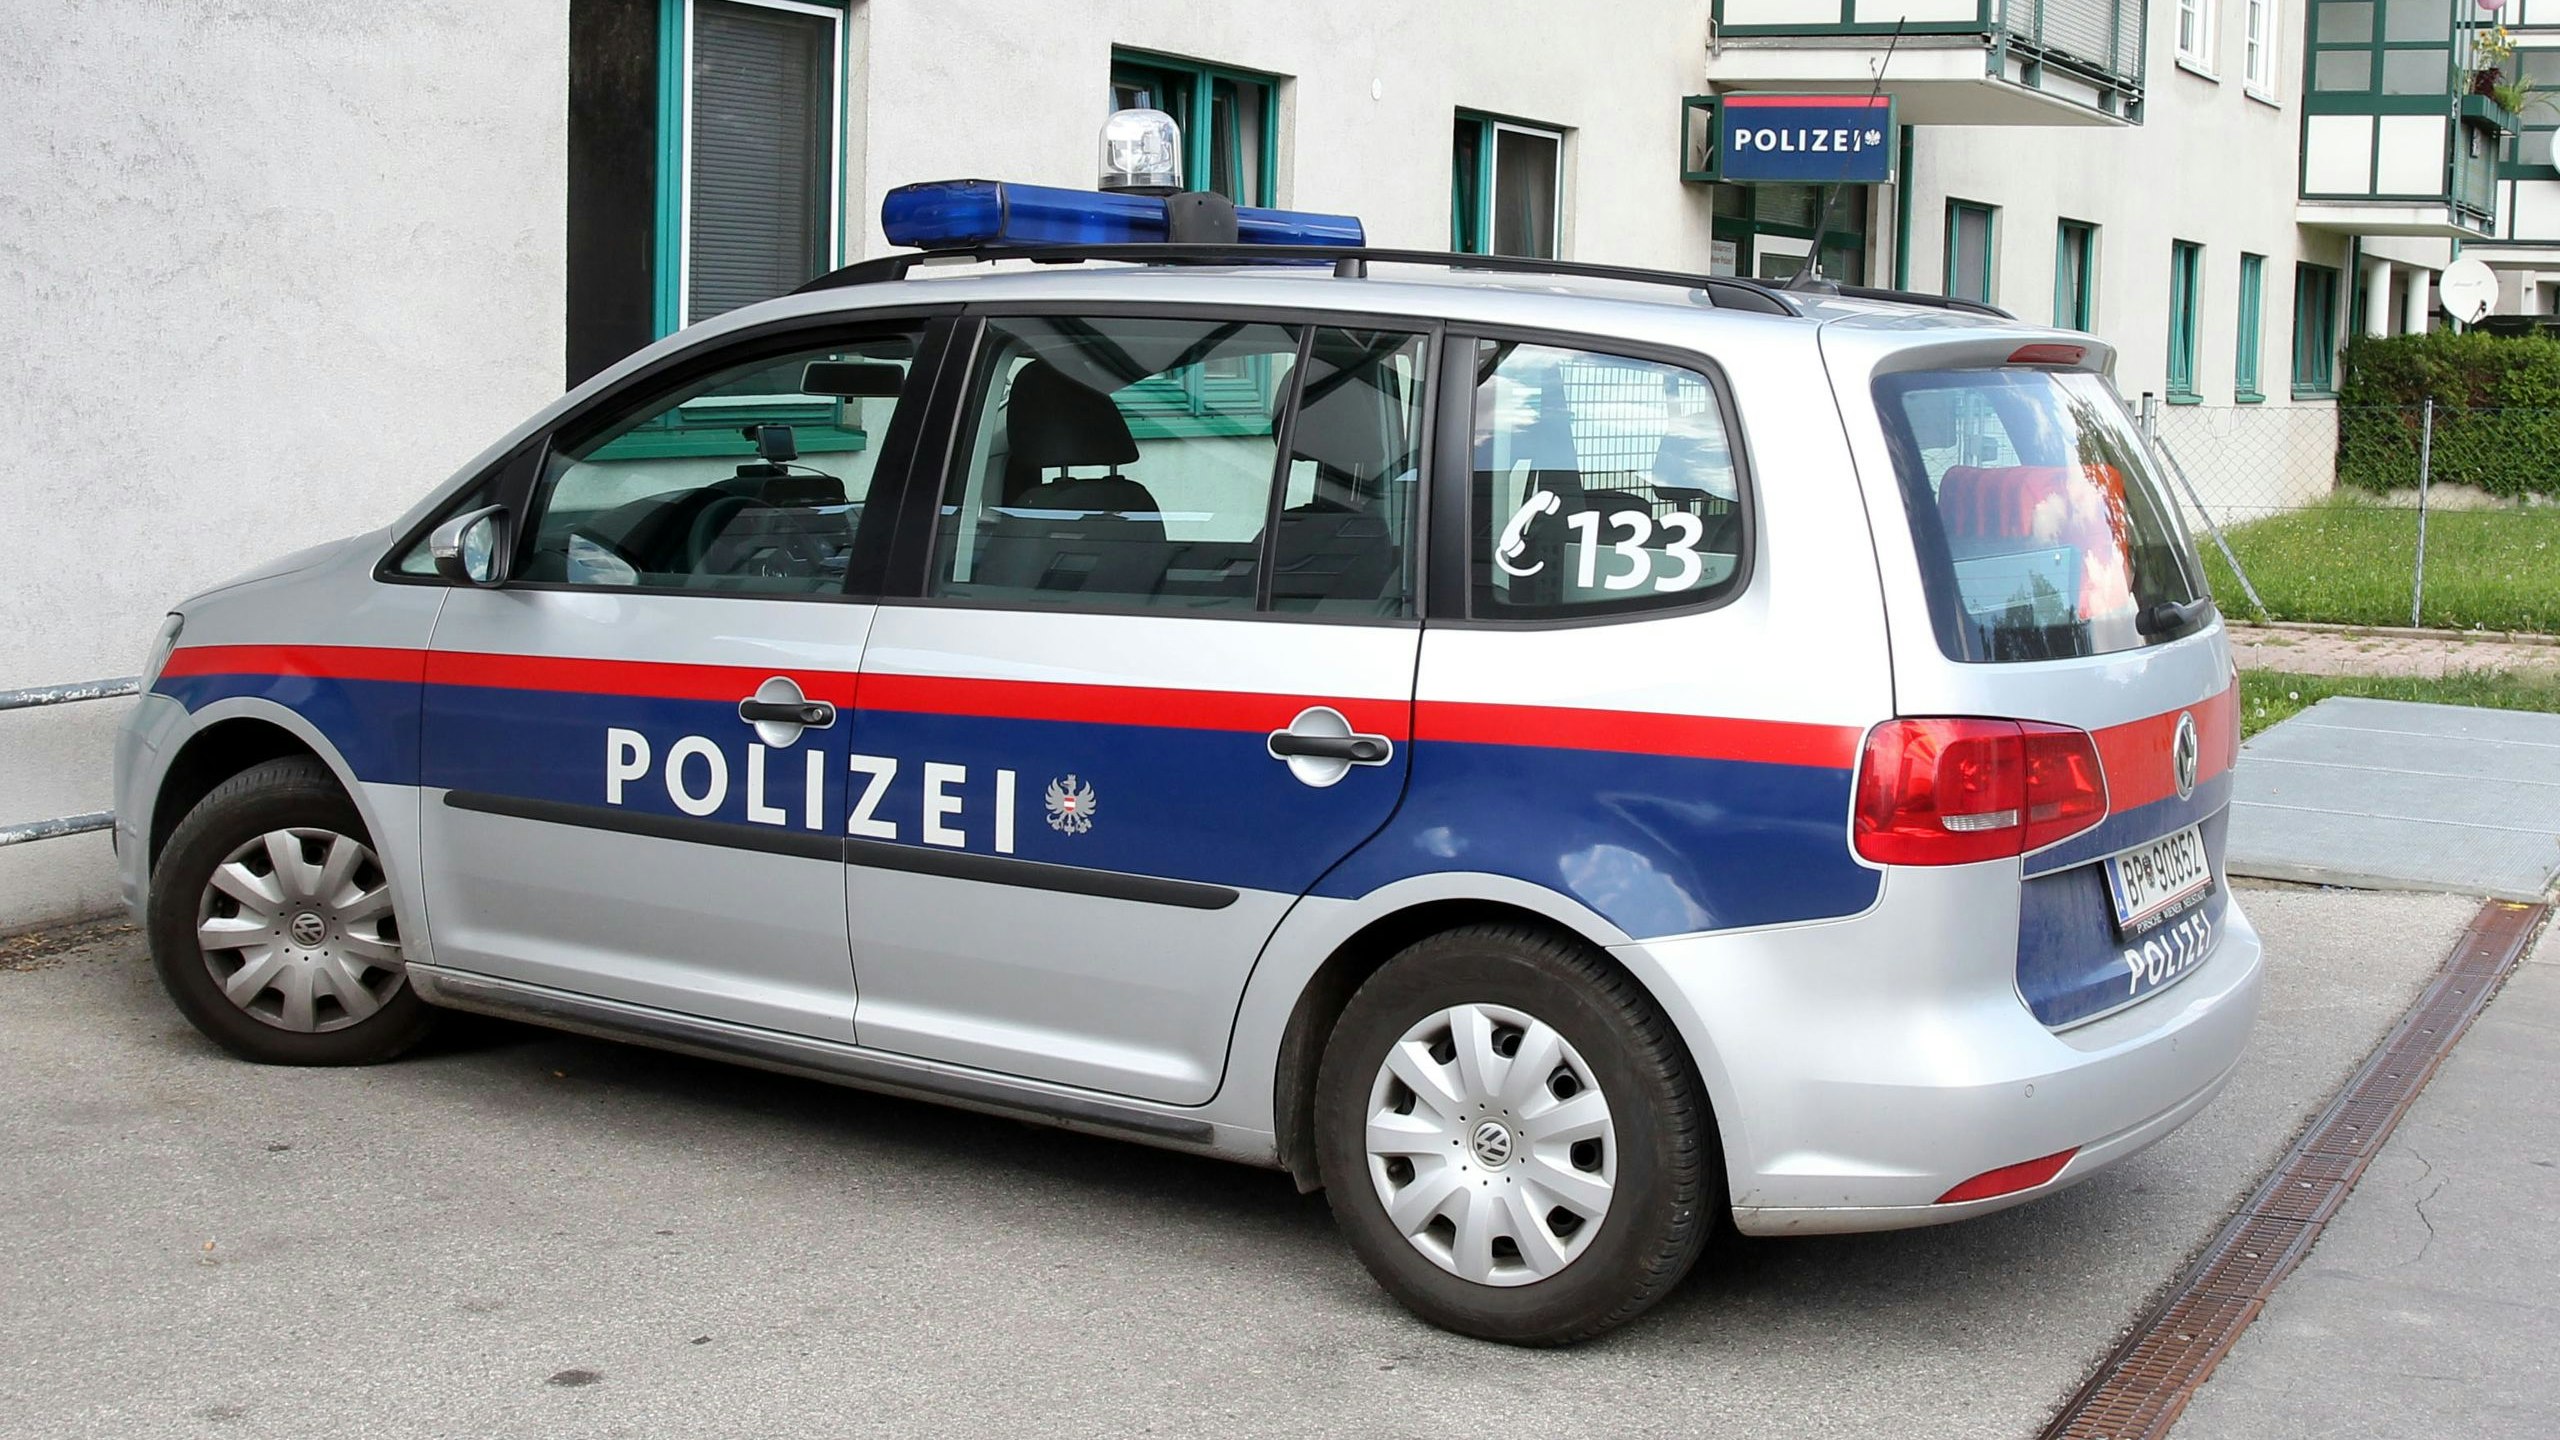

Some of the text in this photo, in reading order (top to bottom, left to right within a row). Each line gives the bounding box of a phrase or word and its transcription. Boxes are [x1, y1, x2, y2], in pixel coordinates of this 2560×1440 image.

[1734, 128, 1862, 152] POLIZEI
[1567, 510, 1703, 592] 133
[607, 728, 1016, 854] POLIZEI
[2118, 897, 2125, 912] A
[2122, 830, 2201, 907] BP 90852
[2123, 910, 2211, 995] POLIZEI
